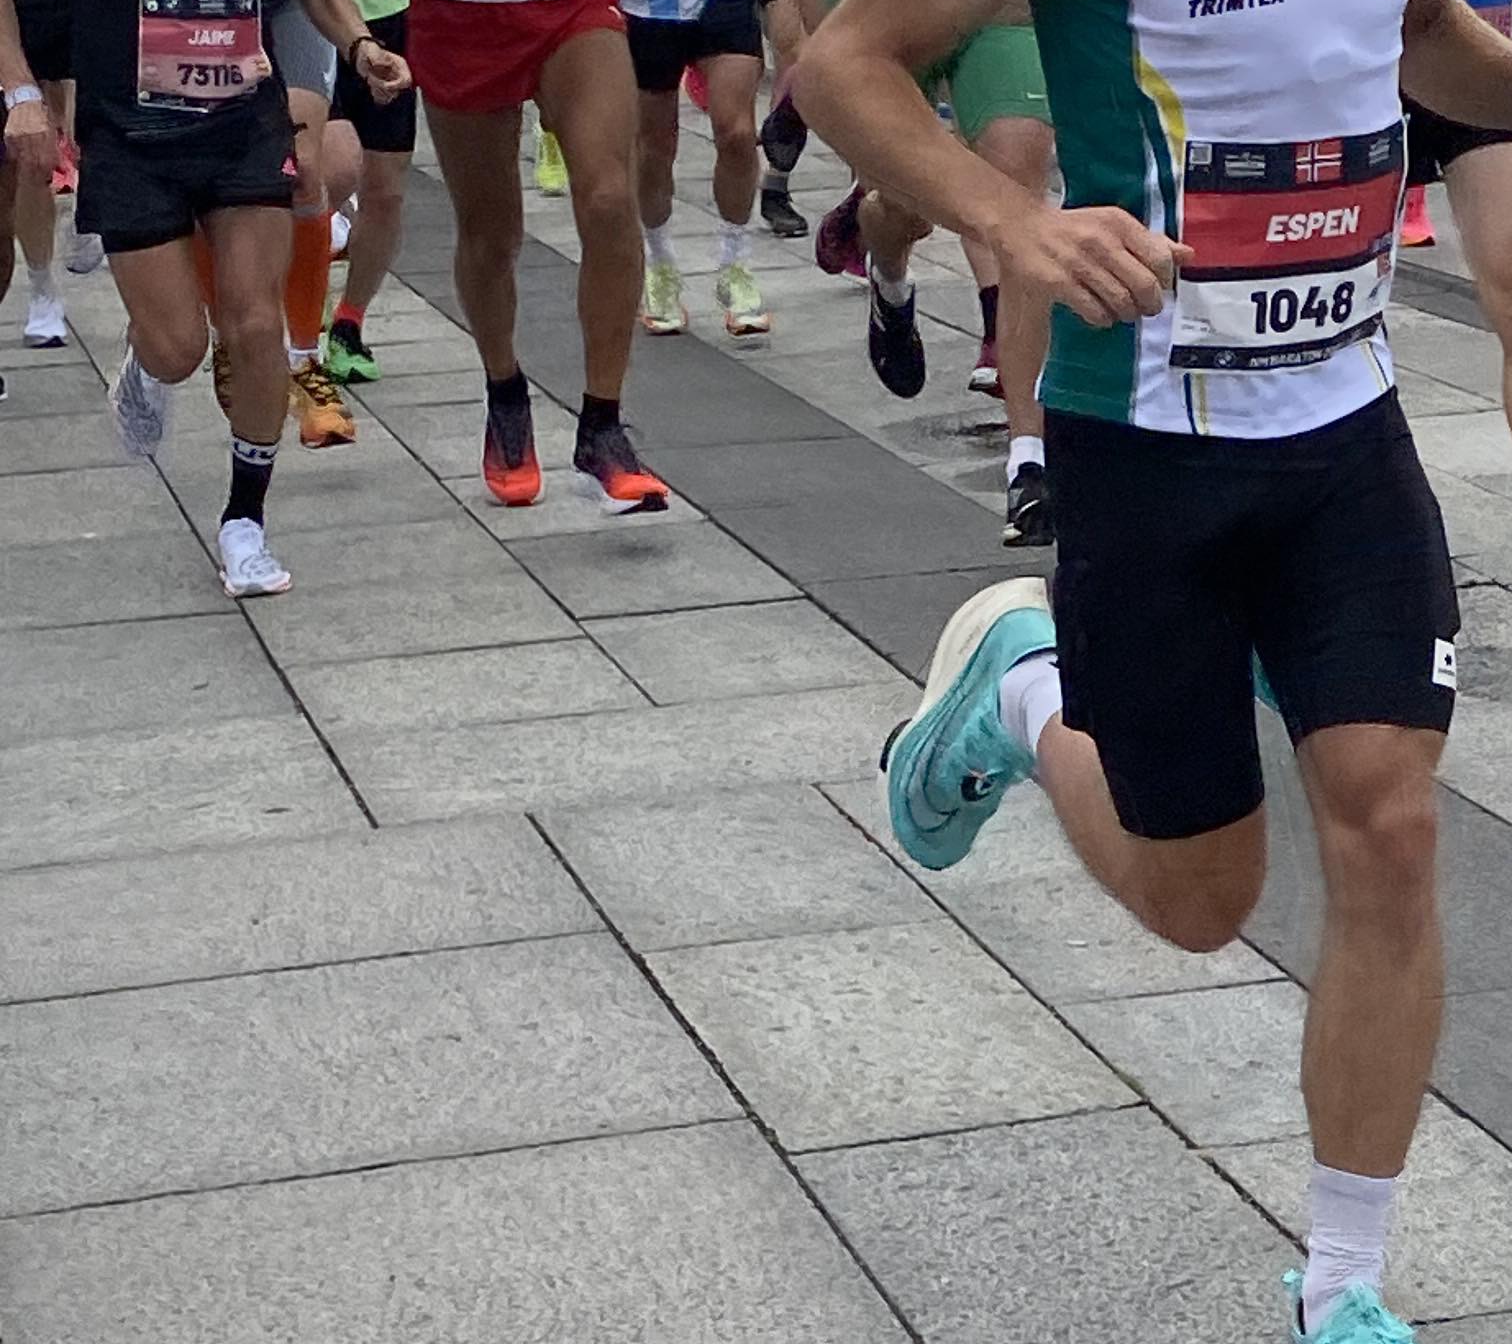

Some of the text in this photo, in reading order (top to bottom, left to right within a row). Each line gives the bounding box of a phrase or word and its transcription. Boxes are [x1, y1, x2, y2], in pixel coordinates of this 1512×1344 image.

[187, 30, 236, 45] JAIME
[1266, 206, 1360, 242] ESPEN
[1250, 281, 1355, 334] 1048
